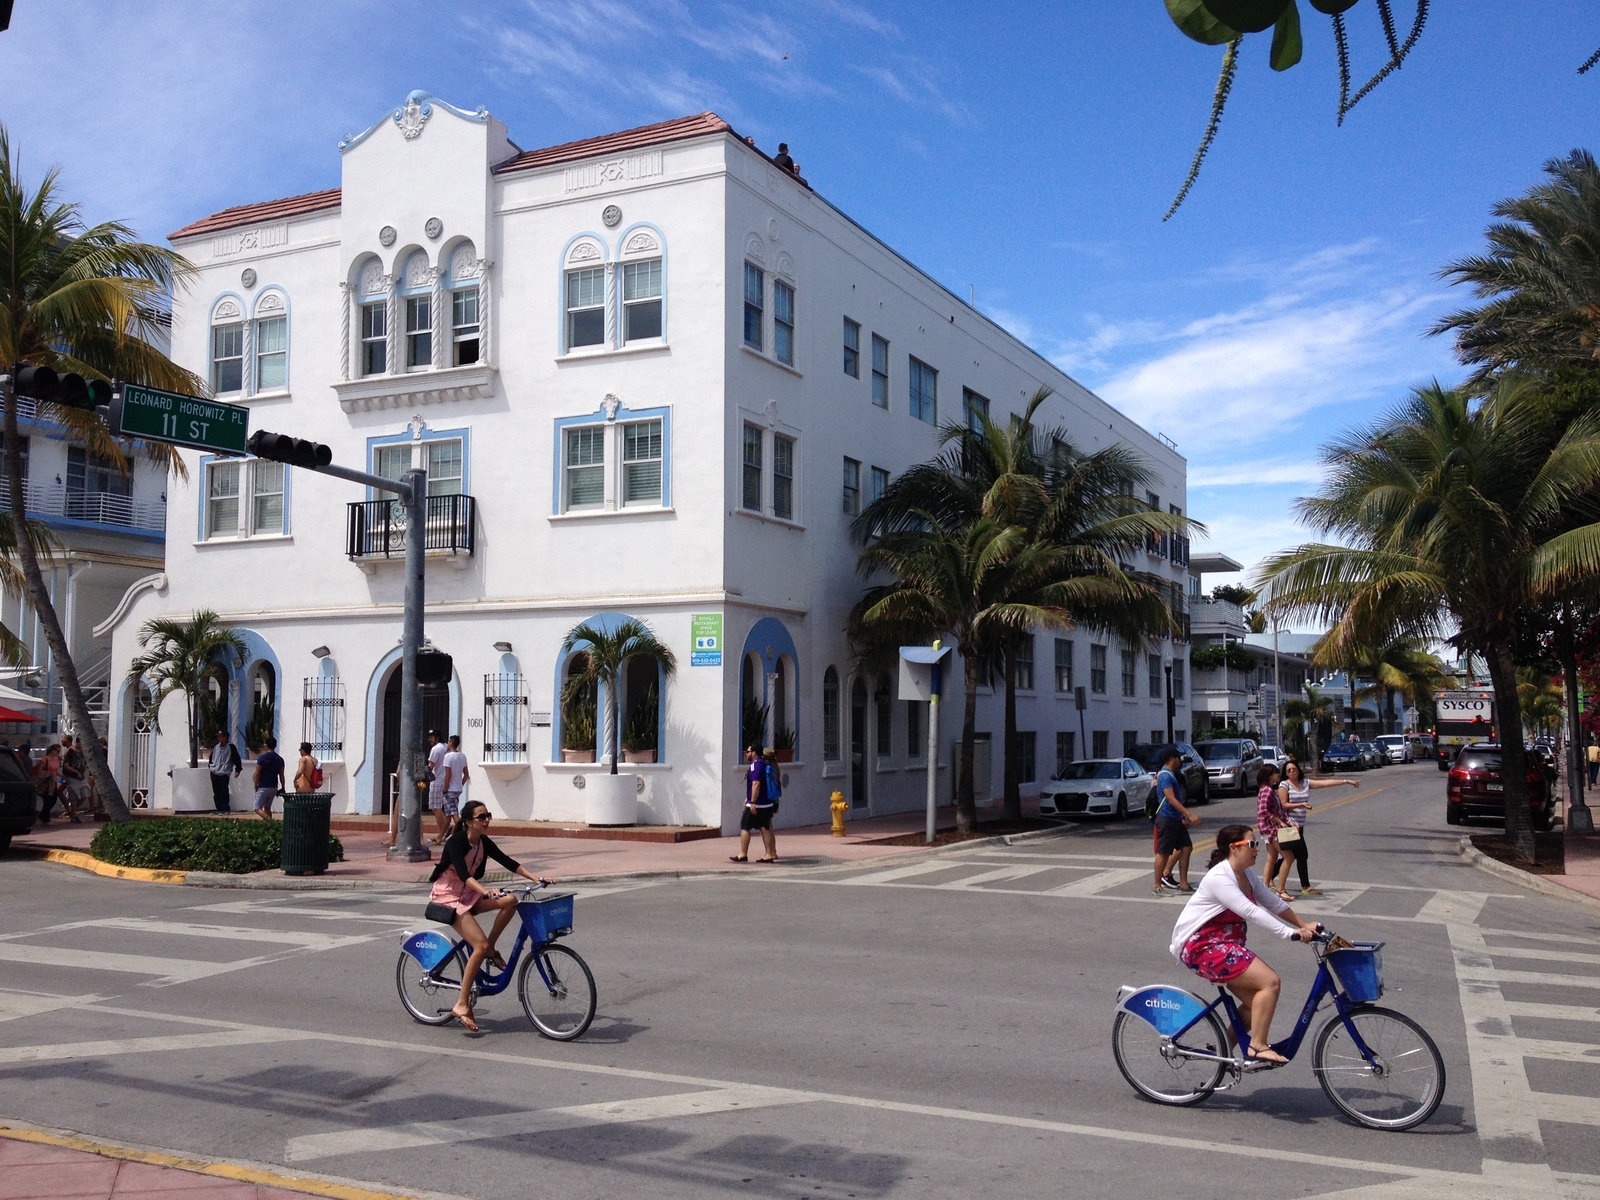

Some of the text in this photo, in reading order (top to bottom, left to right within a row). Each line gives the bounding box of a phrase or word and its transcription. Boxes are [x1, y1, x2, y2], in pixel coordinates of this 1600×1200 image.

[128, 391, 243, 424] LEONARD HOROWITZ PL
[163, 413, 210, 440] 11 ST
[1442, 700, 1484, 710] SYSCO
[467, 718, 483, 727] 1060
[1160, 999, 1181, 1010] bike
